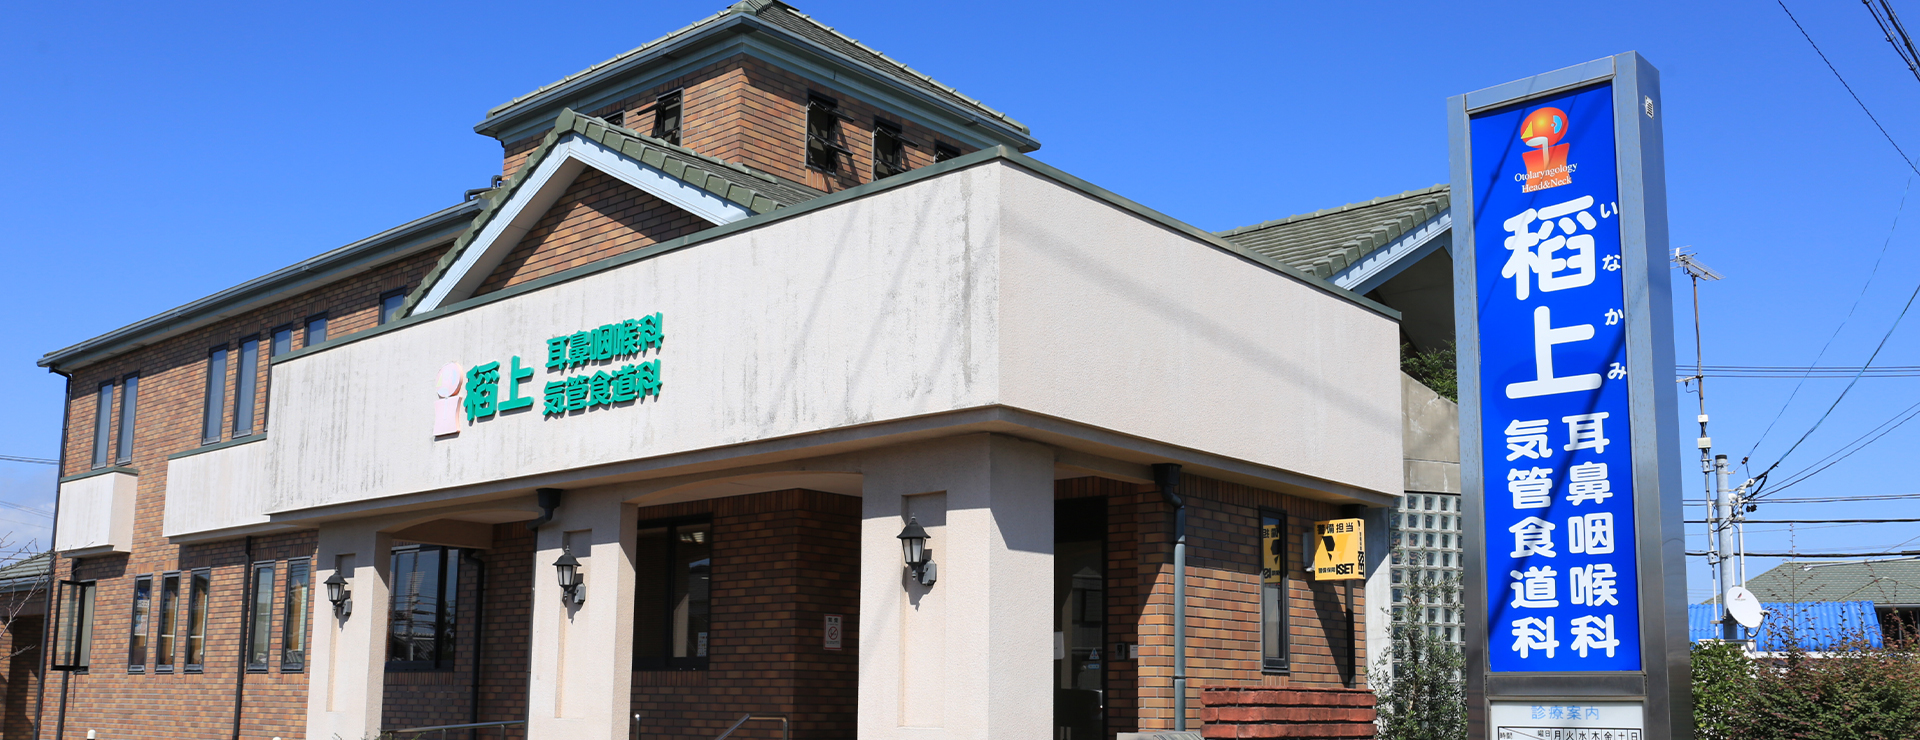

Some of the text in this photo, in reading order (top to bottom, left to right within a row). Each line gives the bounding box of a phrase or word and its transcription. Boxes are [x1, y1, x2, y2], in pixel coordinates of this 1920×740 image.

[1514, 163, 1578, 182] Otolaryngology
[1521, 175, 1573, 194] Head&Neck
[1501, 195, 1602, 399] 稲上
[1600, 201, 1627, 380] いなかみ
[545, 311, 664, 370] 耳鼻咽喉科
[463, 355, 534, 421] 稲上
[542, 358, 662, 417] 気管食道科
[1357, 551, 1365, 577] ISET
[1504, 419, 1559, 659] 気管食道科
[1562, 411, 1620, 658] 耳鼻咽喉科
[1335, 563, 1354, 575] ISET
[1531, 705, 1600, 720] 診療案内
